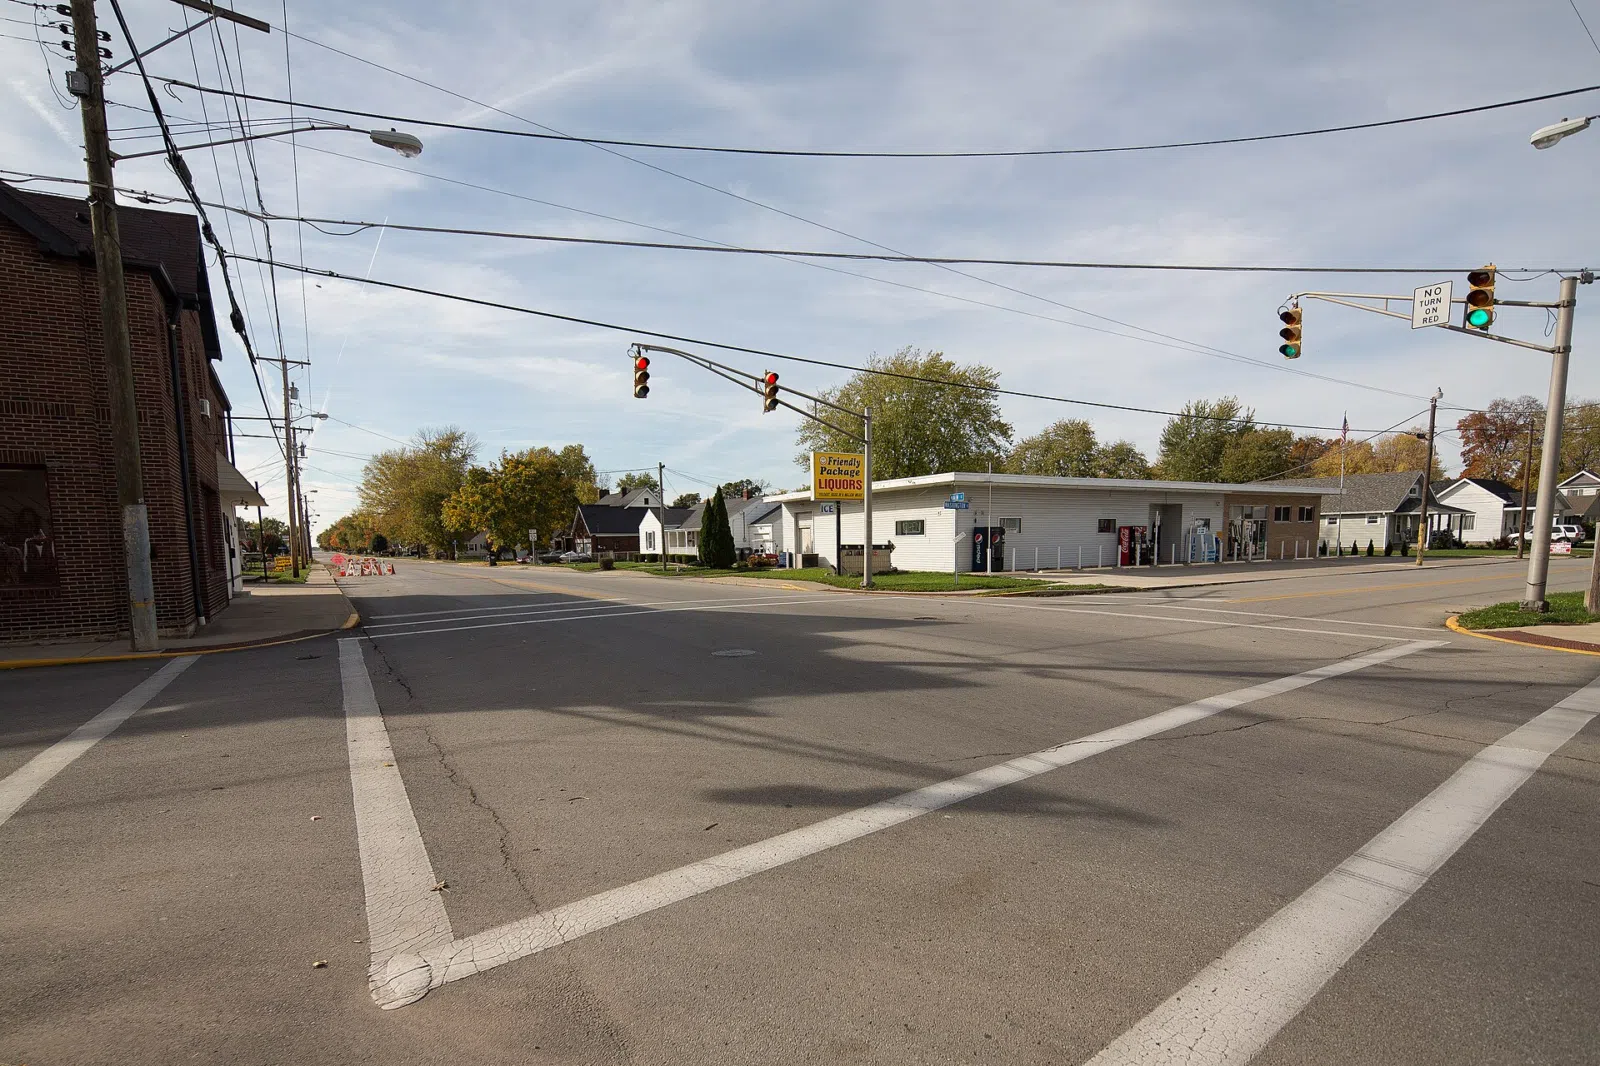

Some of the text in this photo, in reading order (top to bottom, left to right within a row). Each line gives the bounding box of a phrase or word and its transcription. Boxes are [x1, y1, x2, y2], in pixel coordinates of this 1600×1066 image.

[1424, 287, 1442, 298] NO
[1419, 297, 1442, 307] TURN
[1425, 307, 1438, 315] ON
[1422, 315, 1439, 325] RED
[828, 456, 861, 468] Friendly
[820, 466, 861, 478] Package
[818, 479, 863, 491] LIQUORS
[821, 504, 834, 513] ICE
